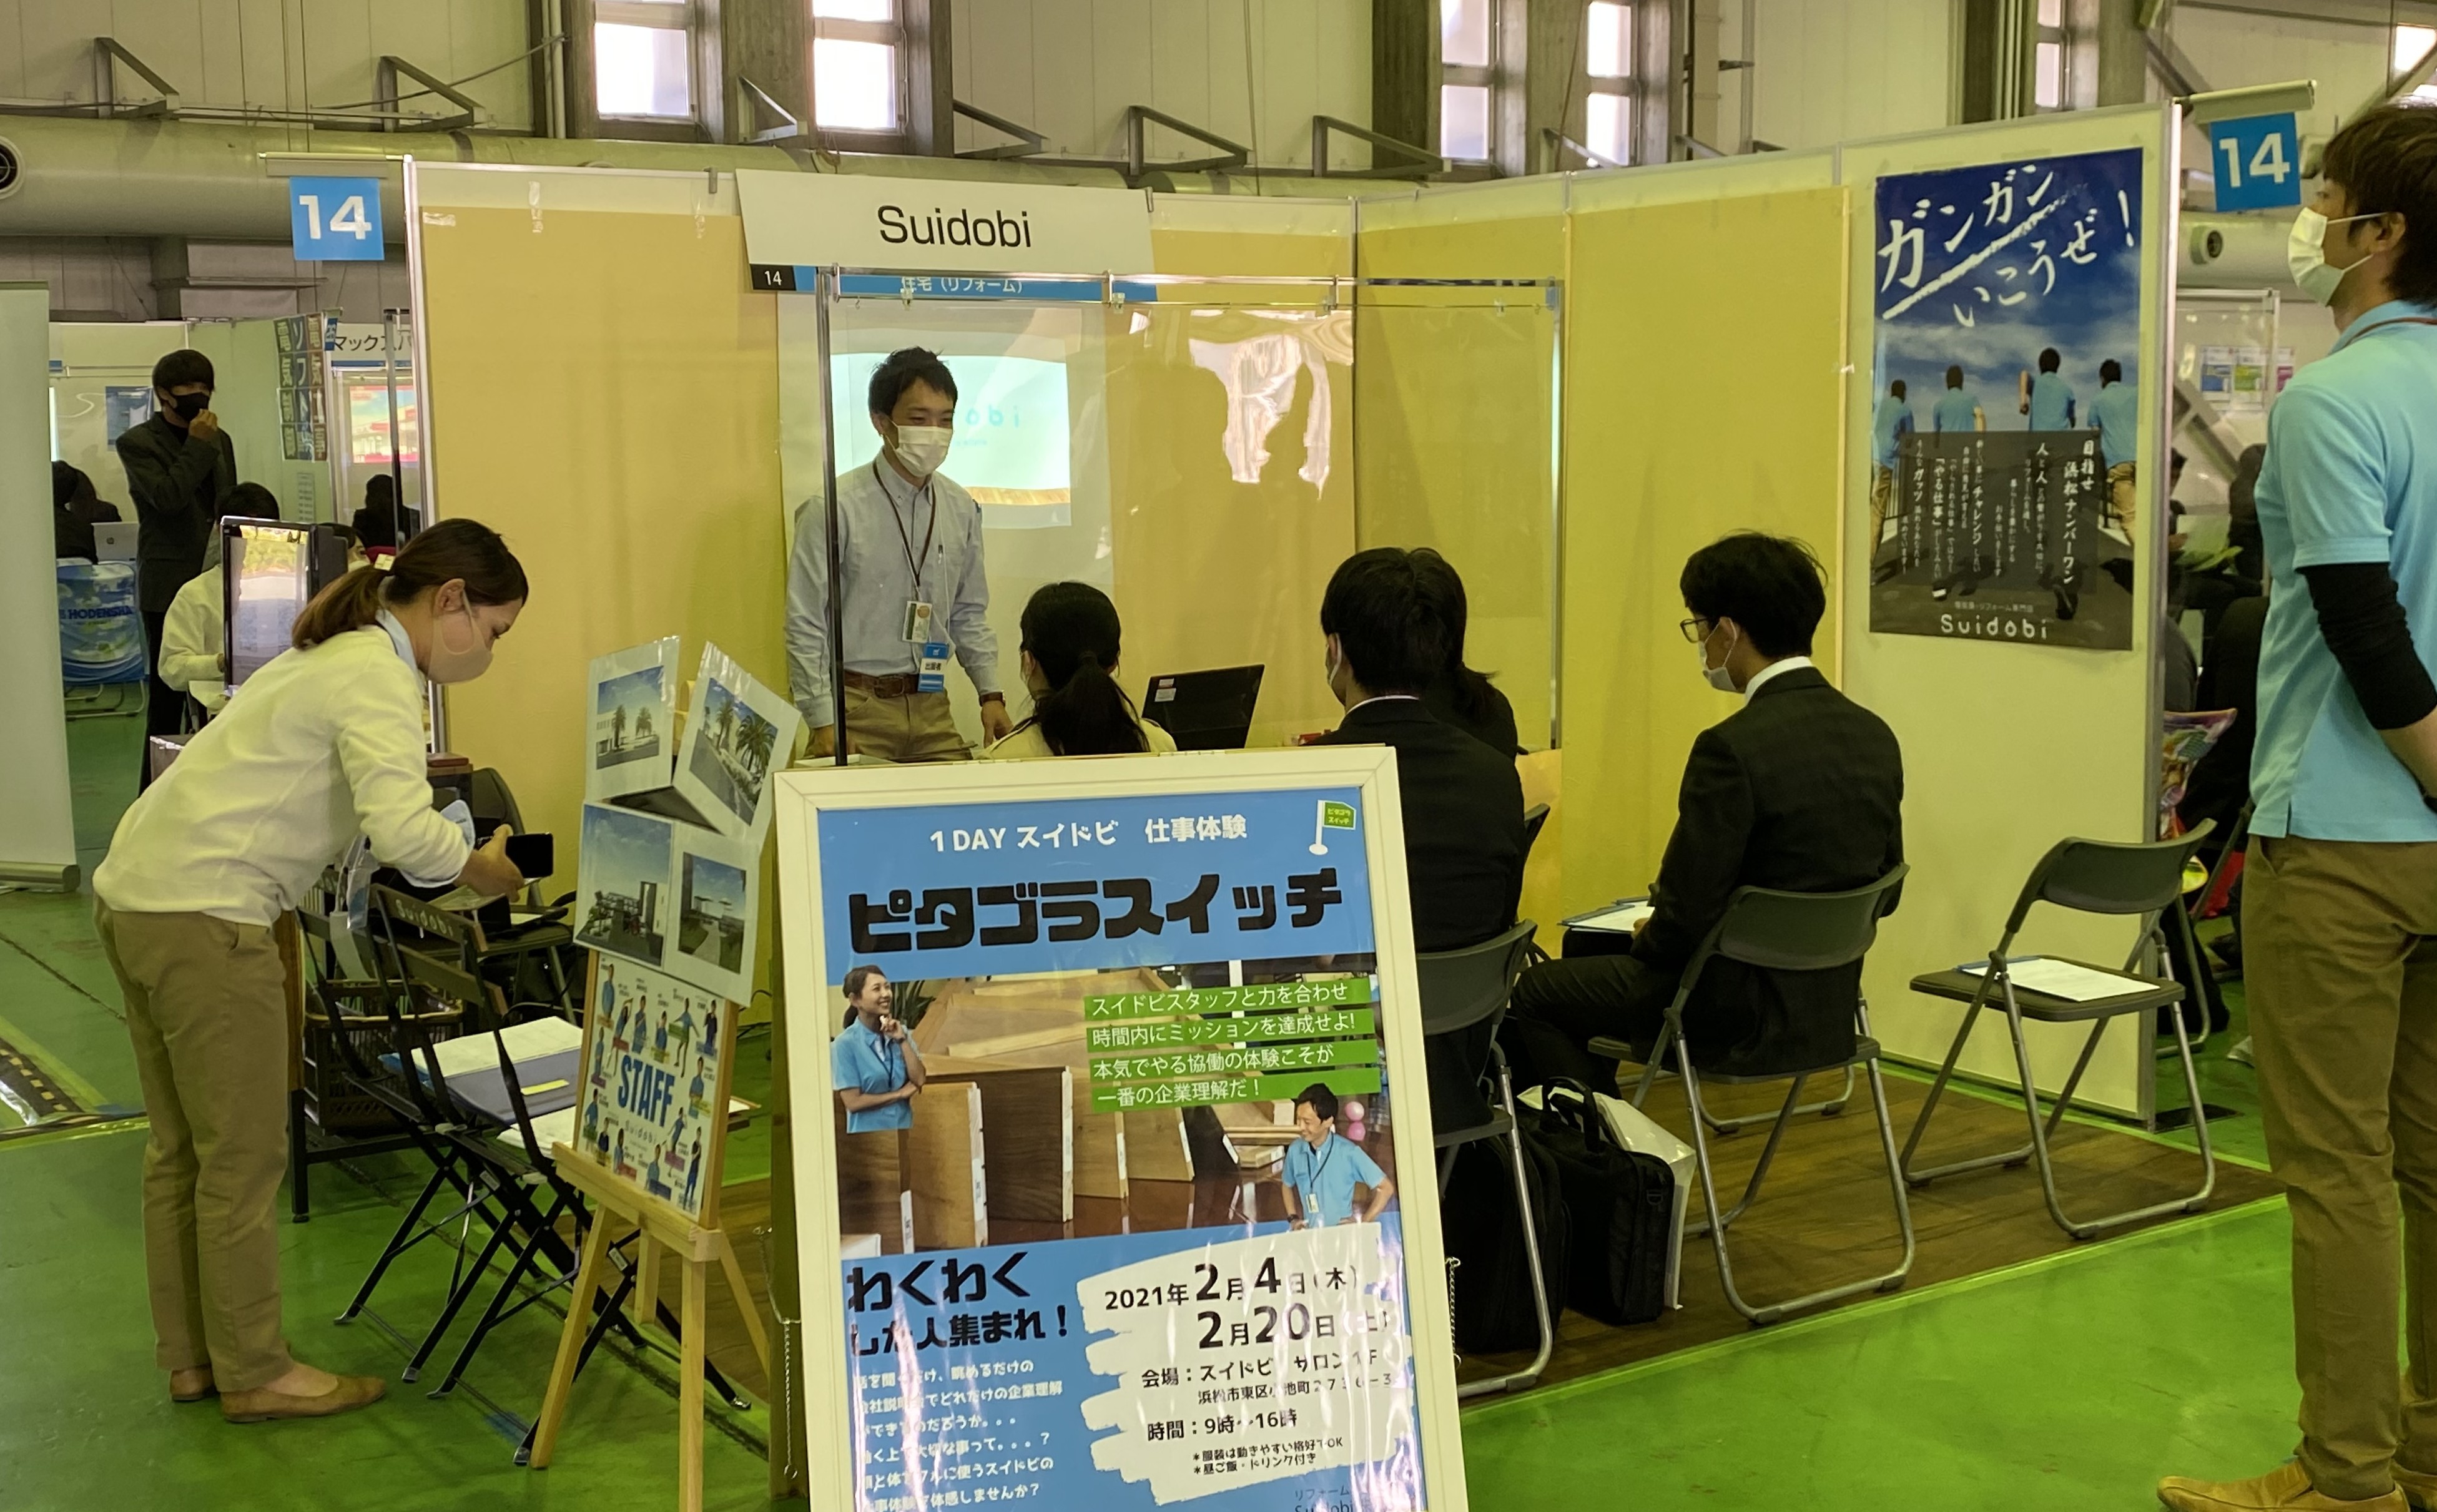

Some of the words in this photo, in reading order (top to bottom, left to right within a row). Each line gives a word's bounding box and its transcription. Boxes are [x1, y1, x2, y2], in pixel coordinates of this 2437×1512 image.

[2220, 132, 2290, 188] 14
[298, 195, 372, 240] 14
[877, 205, 1031, 247] Suidobi
[1878, 164, 2054, 293] ガンガン
[764, 270, 782, 286] 14
[1941, 613, 2047, 641] Suidobi
[1017, 821, 1118, 849] スイドビ
[1145, 814, 1248, 845] 仕事体験
[849, 867, 1343, 955] ピタゴラスイッチ
[1092, 982, 1349, 1017] スイドビスタッフと力を合わせ
[1093, 1044, 1335, 1080] 本気でやる協働の体験こそが
[617, 1054, 676, 1128] STAFF
[1098, 1079, 1261, 1107] 一番の企業理解だ！
[847, 1251, 1031, 1313] わくわく
